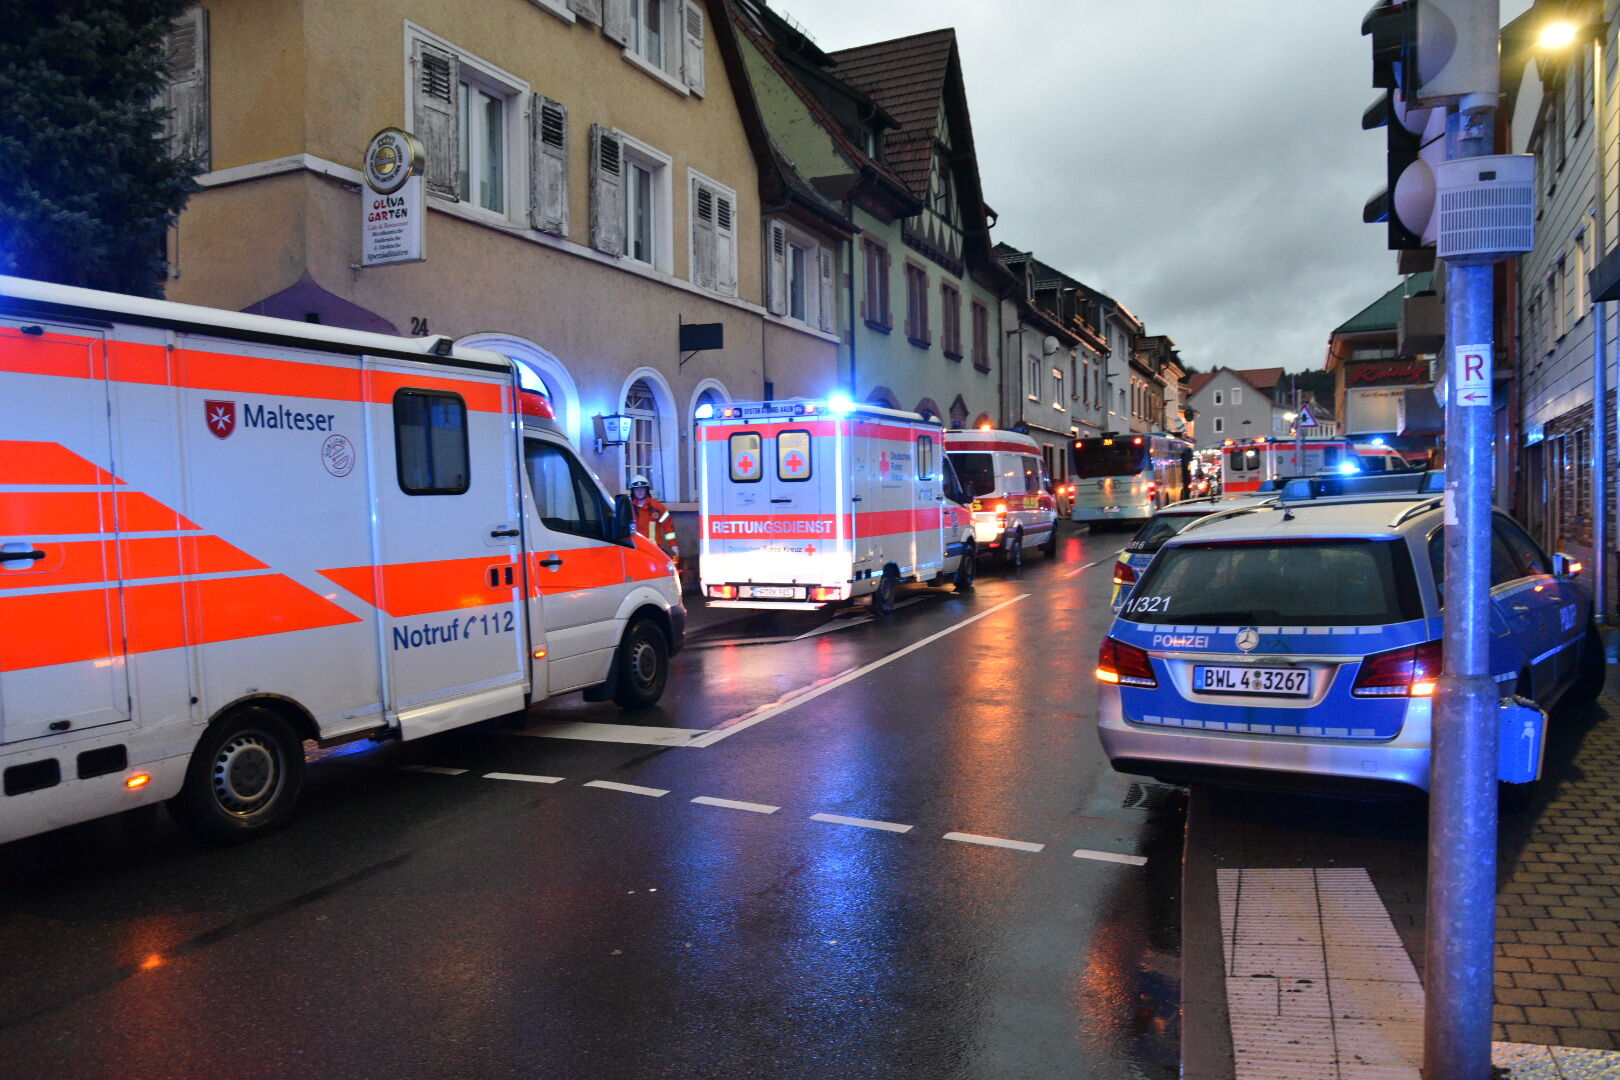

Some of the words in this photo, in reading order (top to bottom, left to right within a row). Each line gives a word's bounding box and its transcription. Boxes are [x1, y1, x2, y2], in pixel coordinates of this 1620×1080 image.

[374, 197, 404, 210] OLIVA
[368, 208, 408, 222] GARTEN
[411, 316, 430, 337] 24
[1465, 354, 1485, 382] R
[243, 403, 335, 432] Malteser
[712, 520, 833, 534] RETTUNGSDIENST
[783, 545, 803, 553] Kreuz
[1126, 596, 1171, 613] 1/321
[393, 618, 459, 651] Notruf
[480, 610, 515, 636] 112
[1152, 634, 1209, 649] POLIZEI
[1205, 669, 1236, 689] BWL
[1240, 671, 1250, 688] 4
[1263, 671, 1306, 692] 3267
